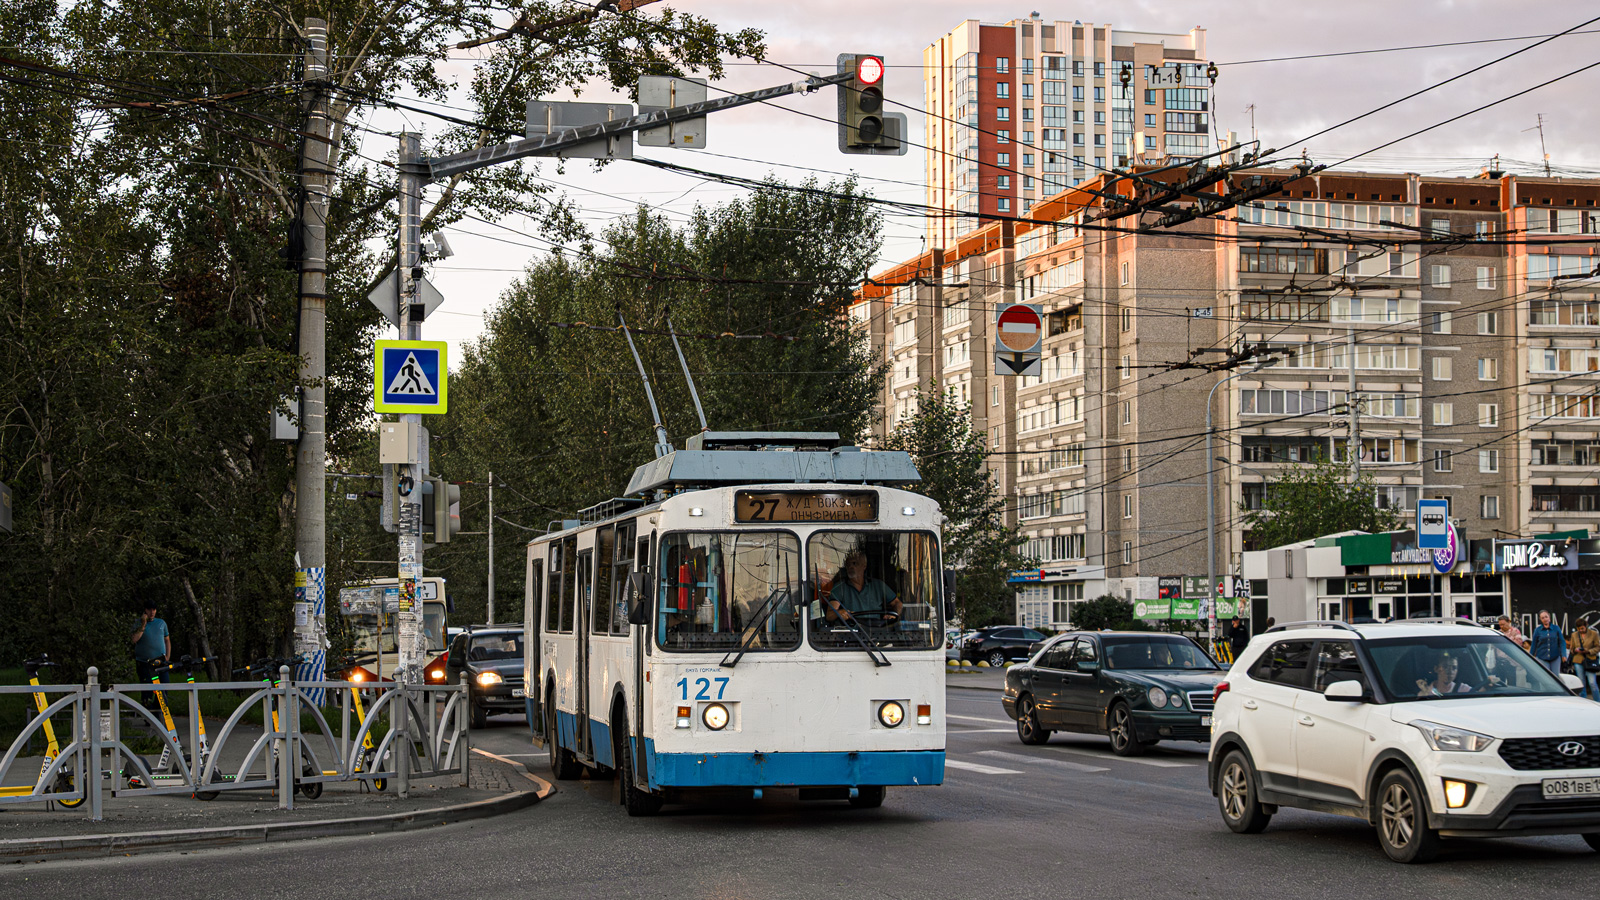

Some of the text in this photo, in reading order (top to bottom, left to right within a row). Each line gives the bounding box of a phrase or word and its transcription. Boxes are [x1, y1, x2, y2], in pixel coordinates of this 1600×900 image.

[1152, 72, 1182, 84] П-19
[749, 498, 780, 521] 27
[786, 497, 861, 508] Ж/Д ВОКЗАЛ
[1503, 545, 1527, 569] ДЫМ
[677, 677, 730, 700] 127
